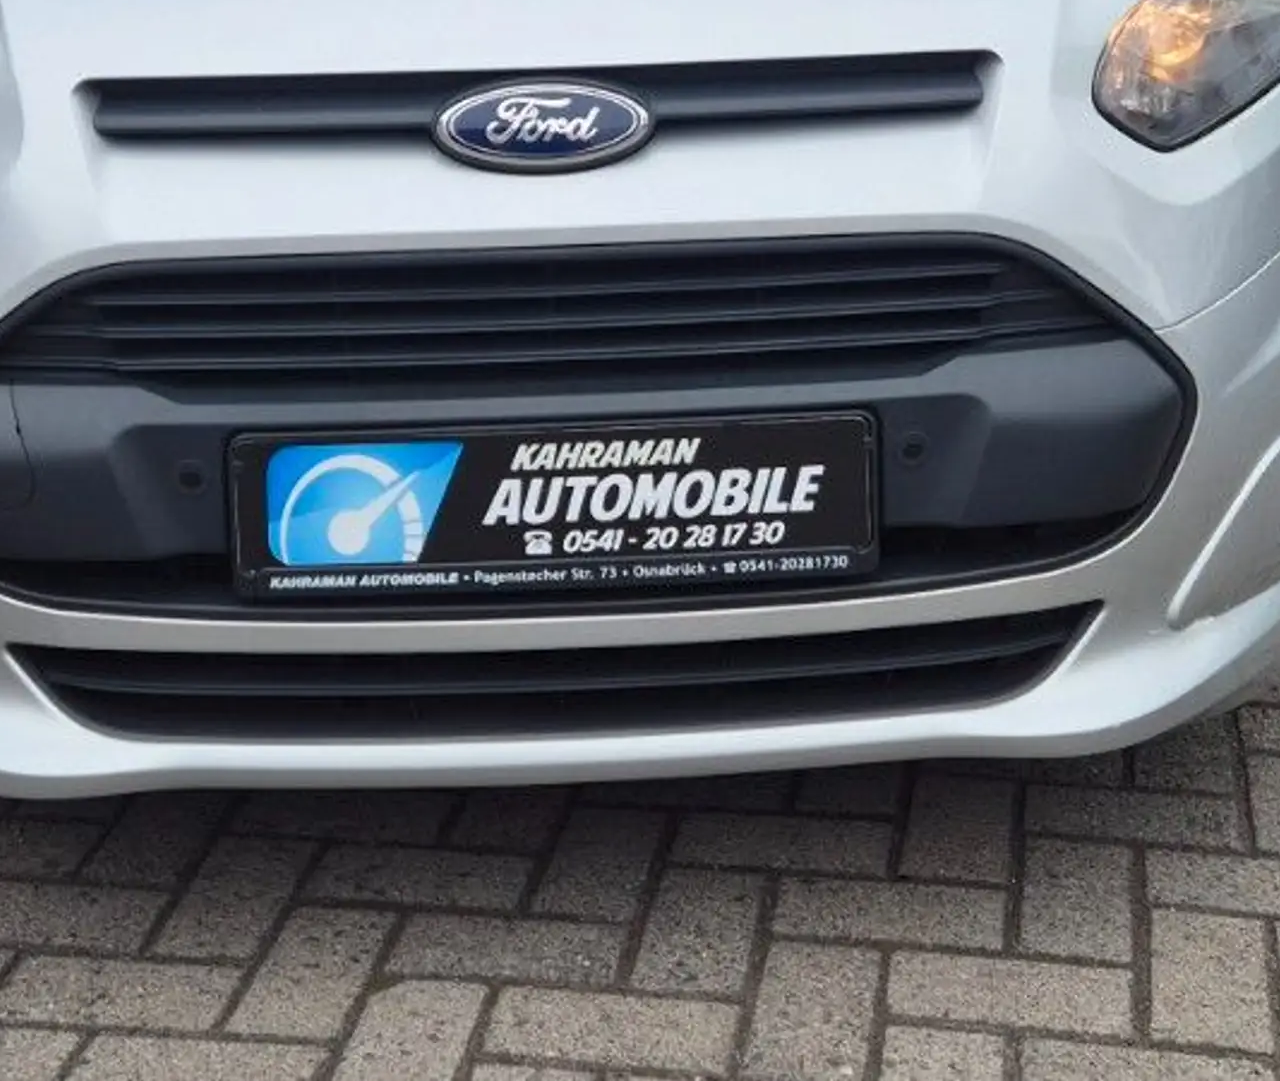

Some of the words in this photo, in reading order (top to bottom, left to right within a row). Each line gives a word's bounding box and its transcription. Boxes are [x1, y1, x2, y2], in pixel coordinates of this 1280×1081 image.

[485, 97, 600, 144] Ford
[510, 438, 701, 472] KAHRAMAN
[482, 465, 825, 526] AUTOMOBILE
[562, 528, 624, 554] 0541
[642, 526, 679, 551] 20
[682, 524, 717, 549] 28
[721, 522, 748, 547] 17
[749, 521, 785, 545] 30
[270, 575, 356, 589] KAHRAMAN
[359, 572, 460, 587] AUTOMOBILE
[473, 569, 565, 585] Pagenstecher
[570, 568, 594, 581] Str.
[600, 567, 618, 579] 73
[633, 563, 706, 579] Osnabrück
[739, 555, 849, 573] 0541-20281730
